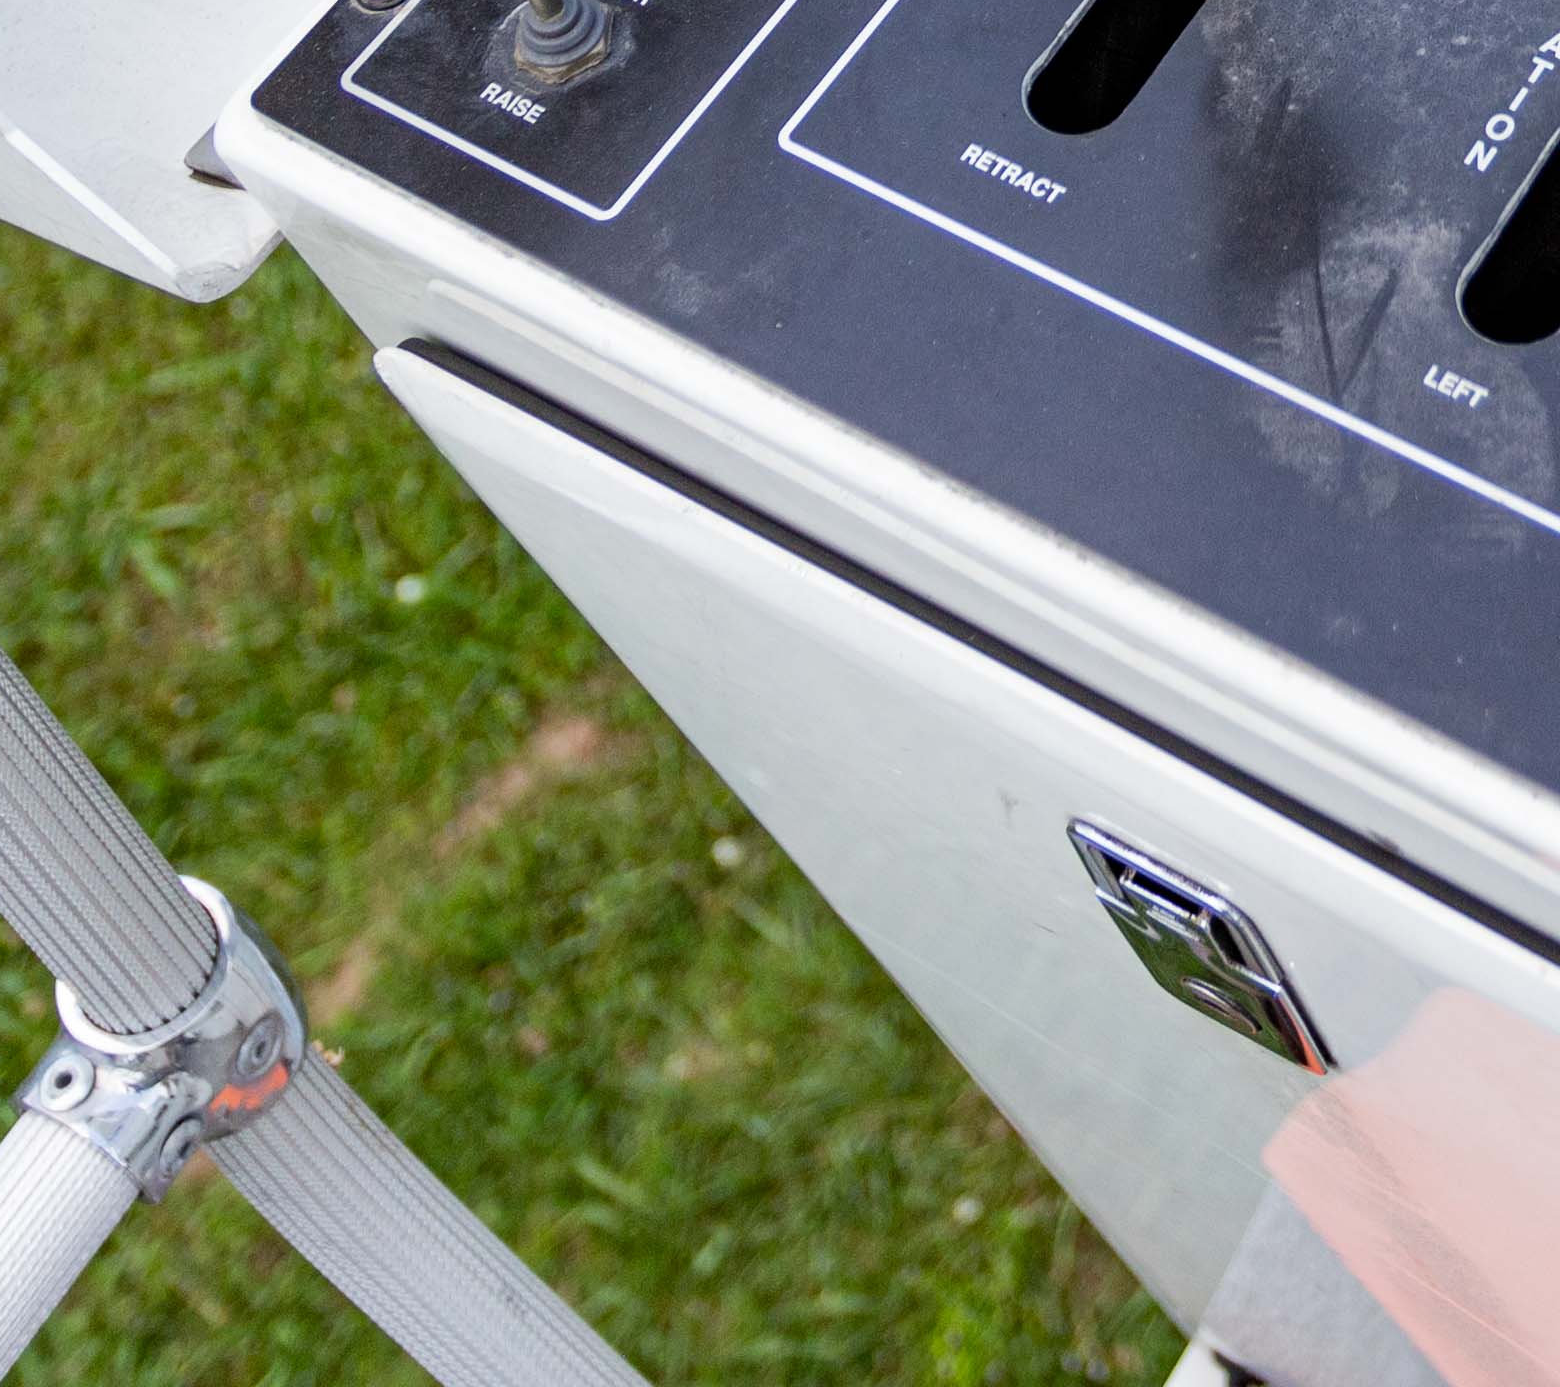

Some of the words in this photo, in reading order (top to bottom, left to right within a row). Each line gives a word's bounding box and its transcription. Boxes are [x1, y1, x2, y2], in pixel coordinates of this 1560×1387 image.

[479, 82, 545, 123] RAISE
[960, 143, 1066, 202] RETRACT
[1423, 364, 1488, 407] LEFT
